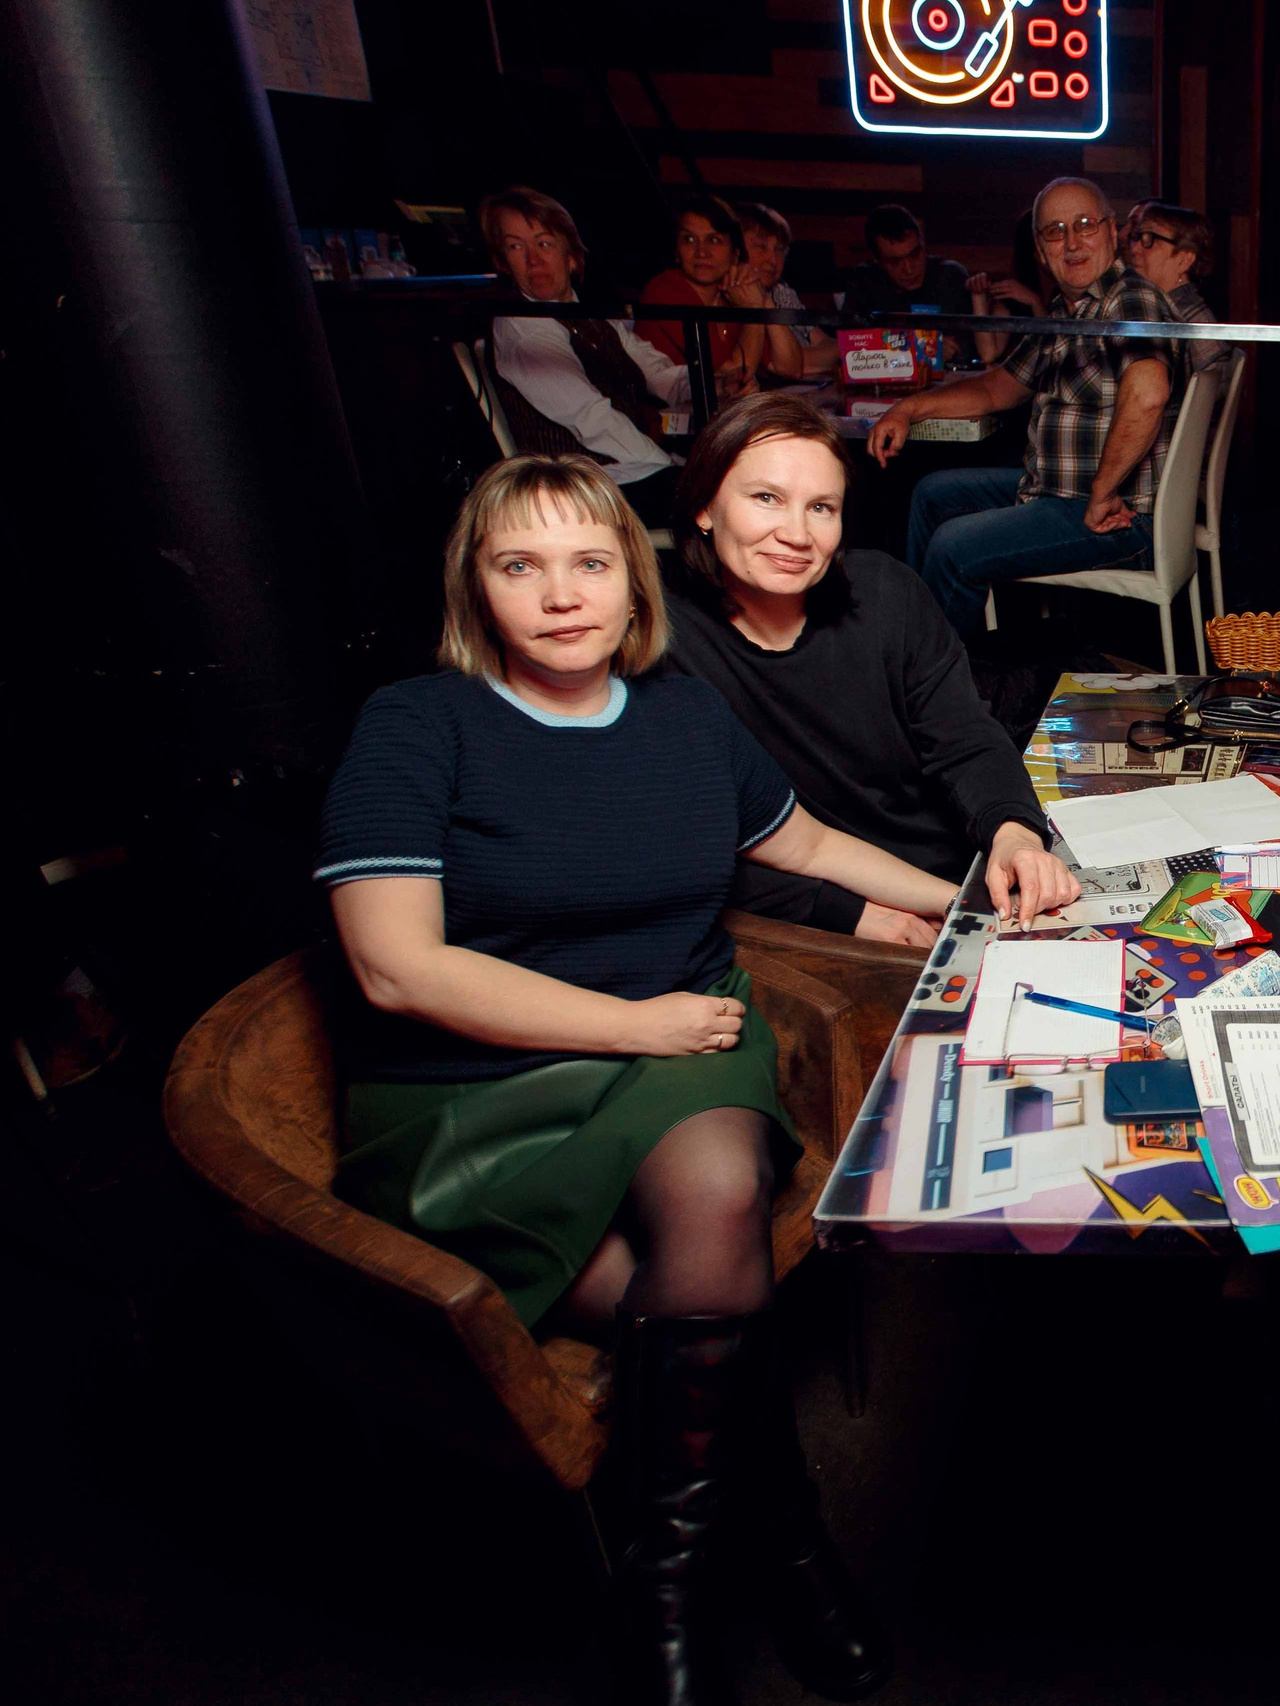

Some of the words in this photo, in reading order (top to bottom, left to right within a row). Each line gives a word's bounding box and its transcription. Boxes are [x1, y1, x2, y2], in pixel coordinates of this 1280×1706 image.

[940, 1053, 957, 1082] Dendy
[1232, 1074, 1246, 1109] САЛАТЫ
[936, 1099, 953, 1123] JUNIOR
